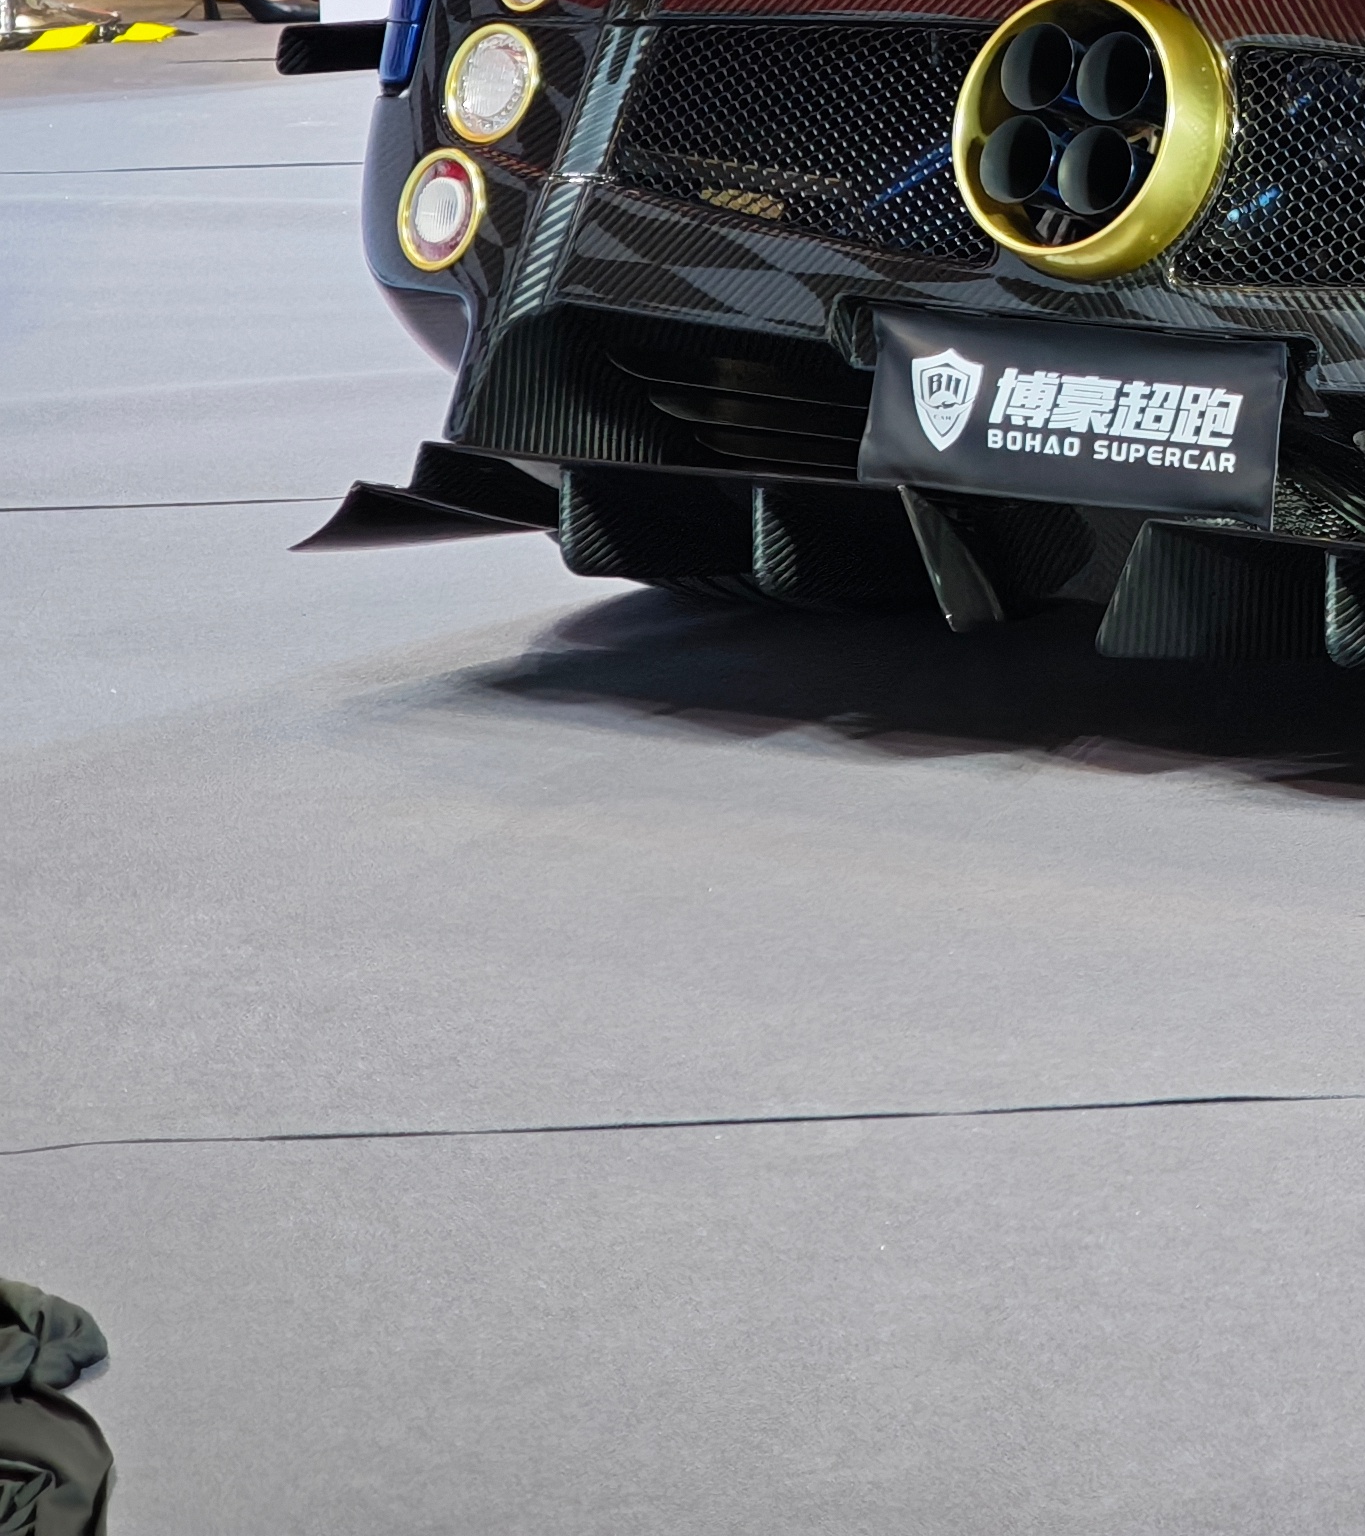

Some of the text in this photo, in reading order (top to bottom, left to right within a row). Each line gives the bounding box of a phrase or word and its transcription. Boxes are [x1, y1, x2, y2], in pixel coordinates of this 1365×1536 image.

[987, 367, 1244, 447] 博豪超跑
[986, 429, 1237, 474] BOHAO SUPERCAR
